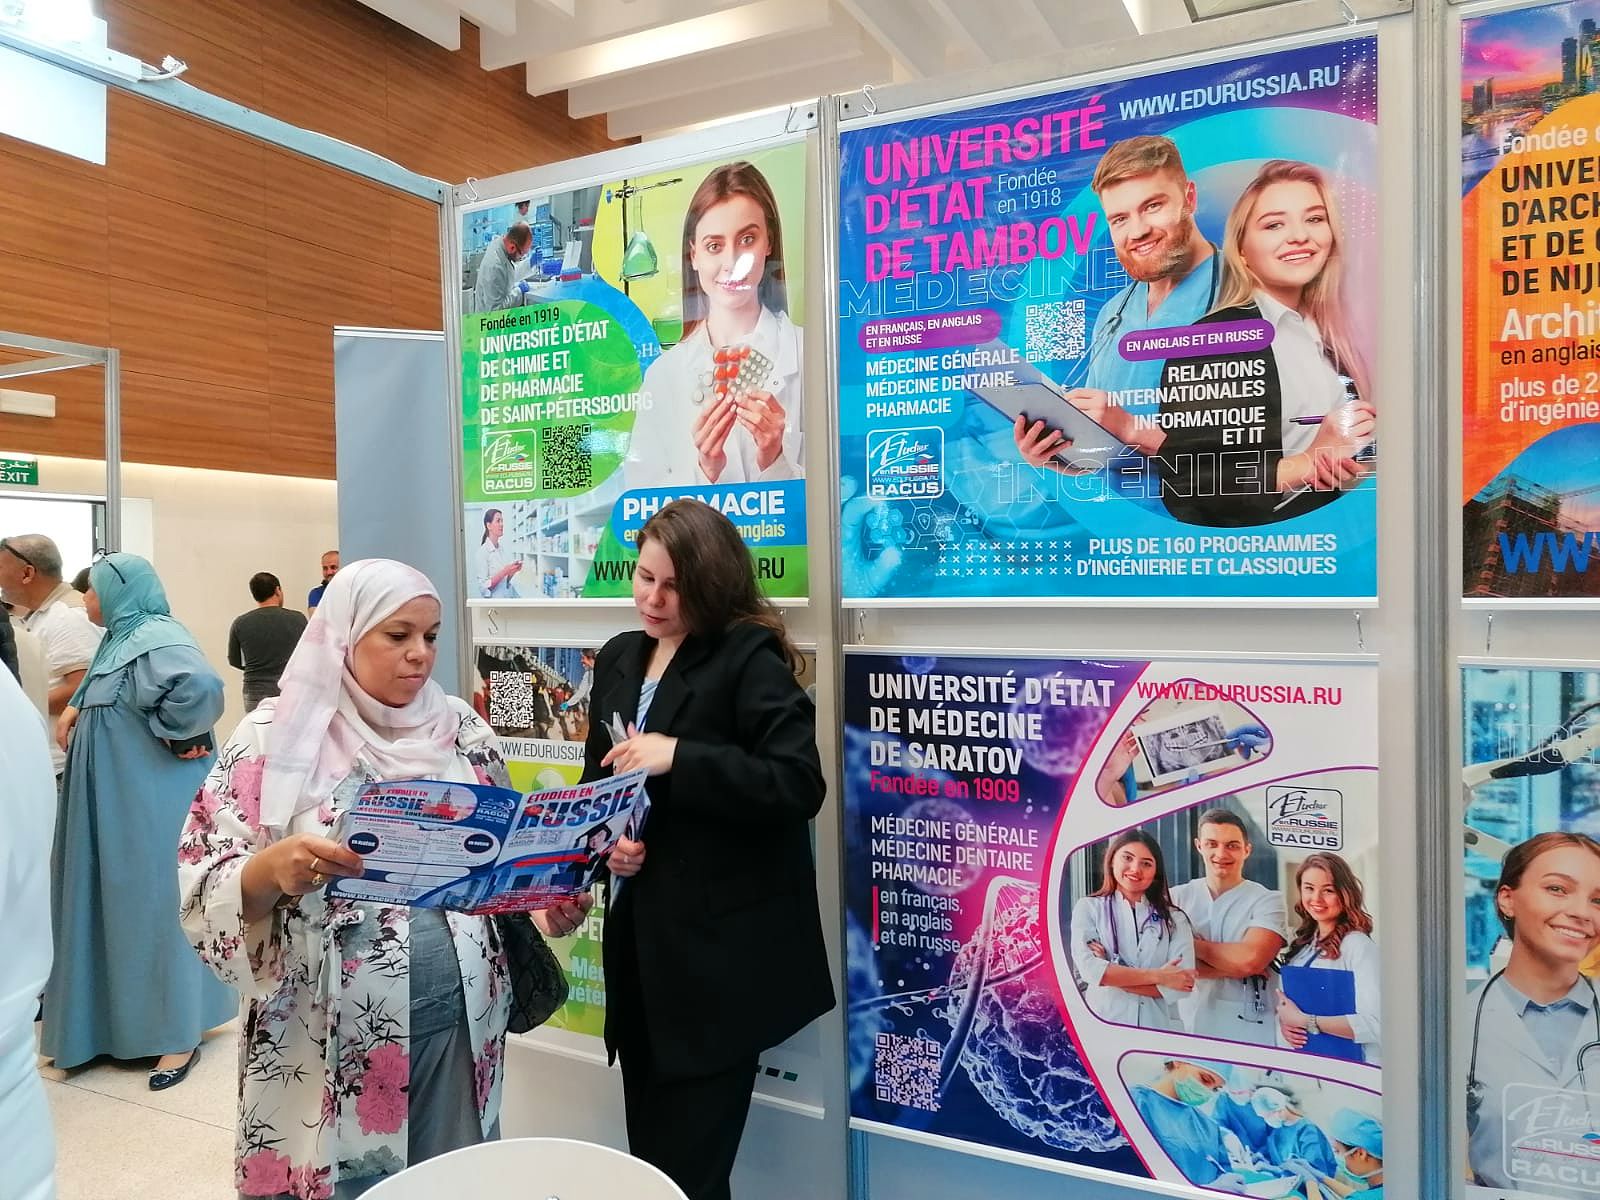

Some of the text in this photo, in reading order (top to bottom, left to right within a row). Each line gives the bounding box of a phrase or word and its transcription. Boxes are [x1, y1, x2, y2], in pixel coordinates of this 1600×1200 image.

[1118, 64, 1341, 121] WWW.EDURUSSIA.RU
[865, 95, 1107, 186] UNIVERSITÉ
[1499, 124, 1588, 156] Fondée
[998, 167, 1058, 193] Fondée
[1501, 156, 1600, 193] UNIVE
[865, 175, 992, 235] D'ÉTAT
[998, 187, 1061, 215] en 1918
[865, 212, 1098, 283] DE TAMBOV
[1501, 233, 1537, 262] ET
[1546, 229, 1585, 258] DE
[1502, 262, 1600, 296] DE NIJ
[480, 307, 560, 331] Fondée en 1919
[865, 314, 982, 336] EN FRANÇAIS, EN ANGLAIS
[480, 319, 609, 354] UNIVERSITÉ D'ÉTAT
[865, 334, 923, 348] ET EN RUSSE
[1126, 328, 1264, 352] EN ANGLAIS ET EN RUSSE
[480, 350, 570, 379] DE CHIMIE ET
[865, 347, 1020, 377] MÉDECINE GÉNÉRALE
[1501, 348, 1526, 365] en
[866, 370, 1015, 398] MÉDECINE DENTAIRE
[1167, 359, 1266, 384] RELATIONS
[480, 373, 584, 402] DE PHARMACIE
[1107, 380, 1266, 408] INTERNATIONALES
[1500, 376, 1546, 402] plus
[1551, 374, 1579, 396] de
[480, 391, 653, 425] DE SAINT-PÉTERSBOURG
[866, 397, 952, 418] PHARMACIE
[1134, 406, 1266, 430] INFORMATIQUE
[1222, 426, 1266, 446] ET IT
[890, 464, 939, 475] RUSSIE
[485, 478, 533, 490] RACUS
[872, 482, 939, 496] RACUS
[624, 490, 785, 521] PHMACIE
[1089, 533, 1337, 555] PLUS DE 160 PROGRAMMES
[1498, 531, 1600, 574] WW
[1076, 555, 1337, 577] D'INGÉNIERIE ET CLASSIQUES
[869, 670, 1115, 708] UNIVERSITÉ D'ÉTAT
[1137, 681, 1342, 706] WWW.EDURUSSIA.RU
[870, 703, 1043, 741] DE MÉDECINE
[500, 741, 585, 761] WW.EDURUSSIA
[870, 740, 1023, 776] DE SARATOV
[579, 786, 594, 798] EN
[870, 771, 1020, 803] Fondée en 1909
[515, 782, 639, 831] RUSSIE
[871, 813, 1039, 848] MÉDECINE GÉNÉRALE
[1290, 818, 1338, 829] RUSSIE
[1272, 832, 1338, 847] RACUS
[871, 836, 1033, 872] MÉDECINE DENTAIRE
[872, 861, 962, 887] PHARMACIE
[880, 888, 963, 915] en français,
[880, 911, 953, 933] en anglais
[880, 929, 961, 953] et en russe
